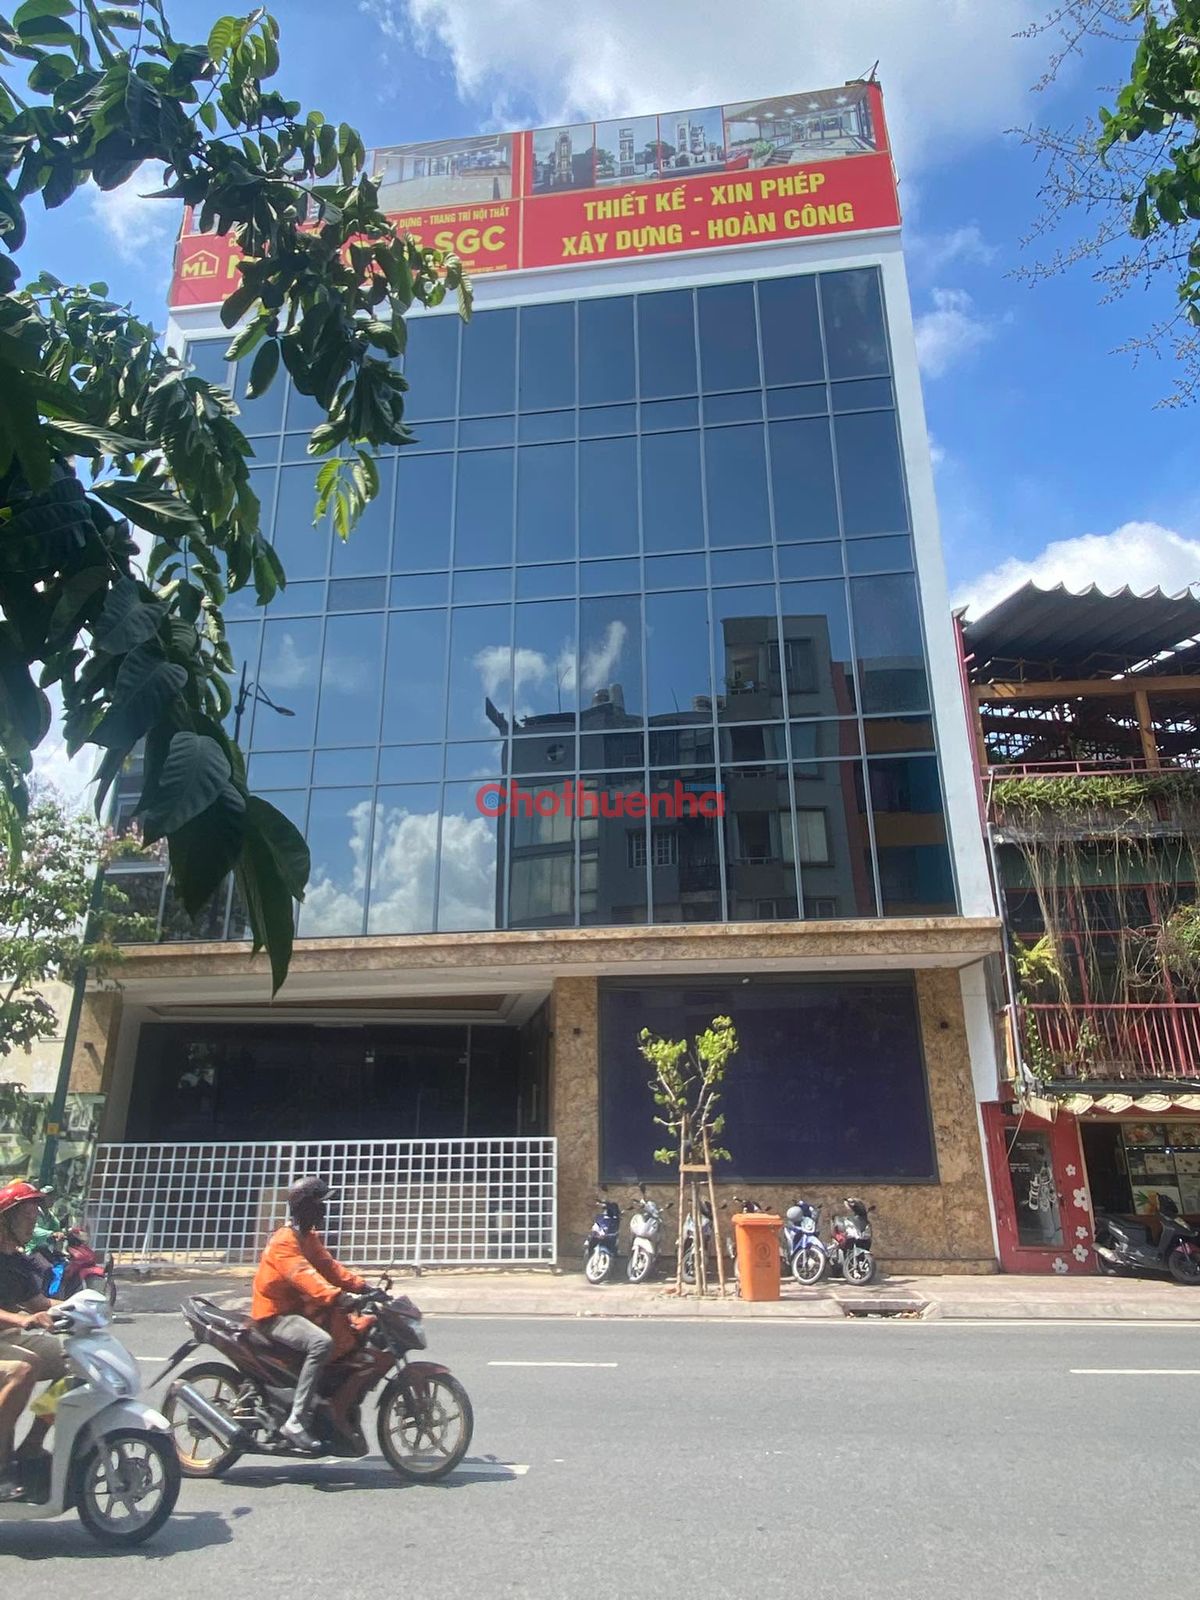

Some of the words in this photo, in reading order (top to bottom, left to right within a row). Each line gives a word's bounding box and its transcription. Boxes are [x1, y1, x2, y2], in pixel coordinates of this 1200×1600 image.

[584, 191, 648, 221] THIẾT
[656, 184, 687, 212] KẾ
[711, 182, 753, 206] XIN
[761, 171, 825, 199] PHÉP
[430, 213, 456, 225] TRANG
[562, 231, 608, 257] XÂY
[616, 224, 683, 252] DỰNG
[707, 211, 776, 240] HOÀN
[784, 203, 855, 230] CÔNG
[434, 225, 506, 255] SGC
[181, 261, 214, 278] ML
